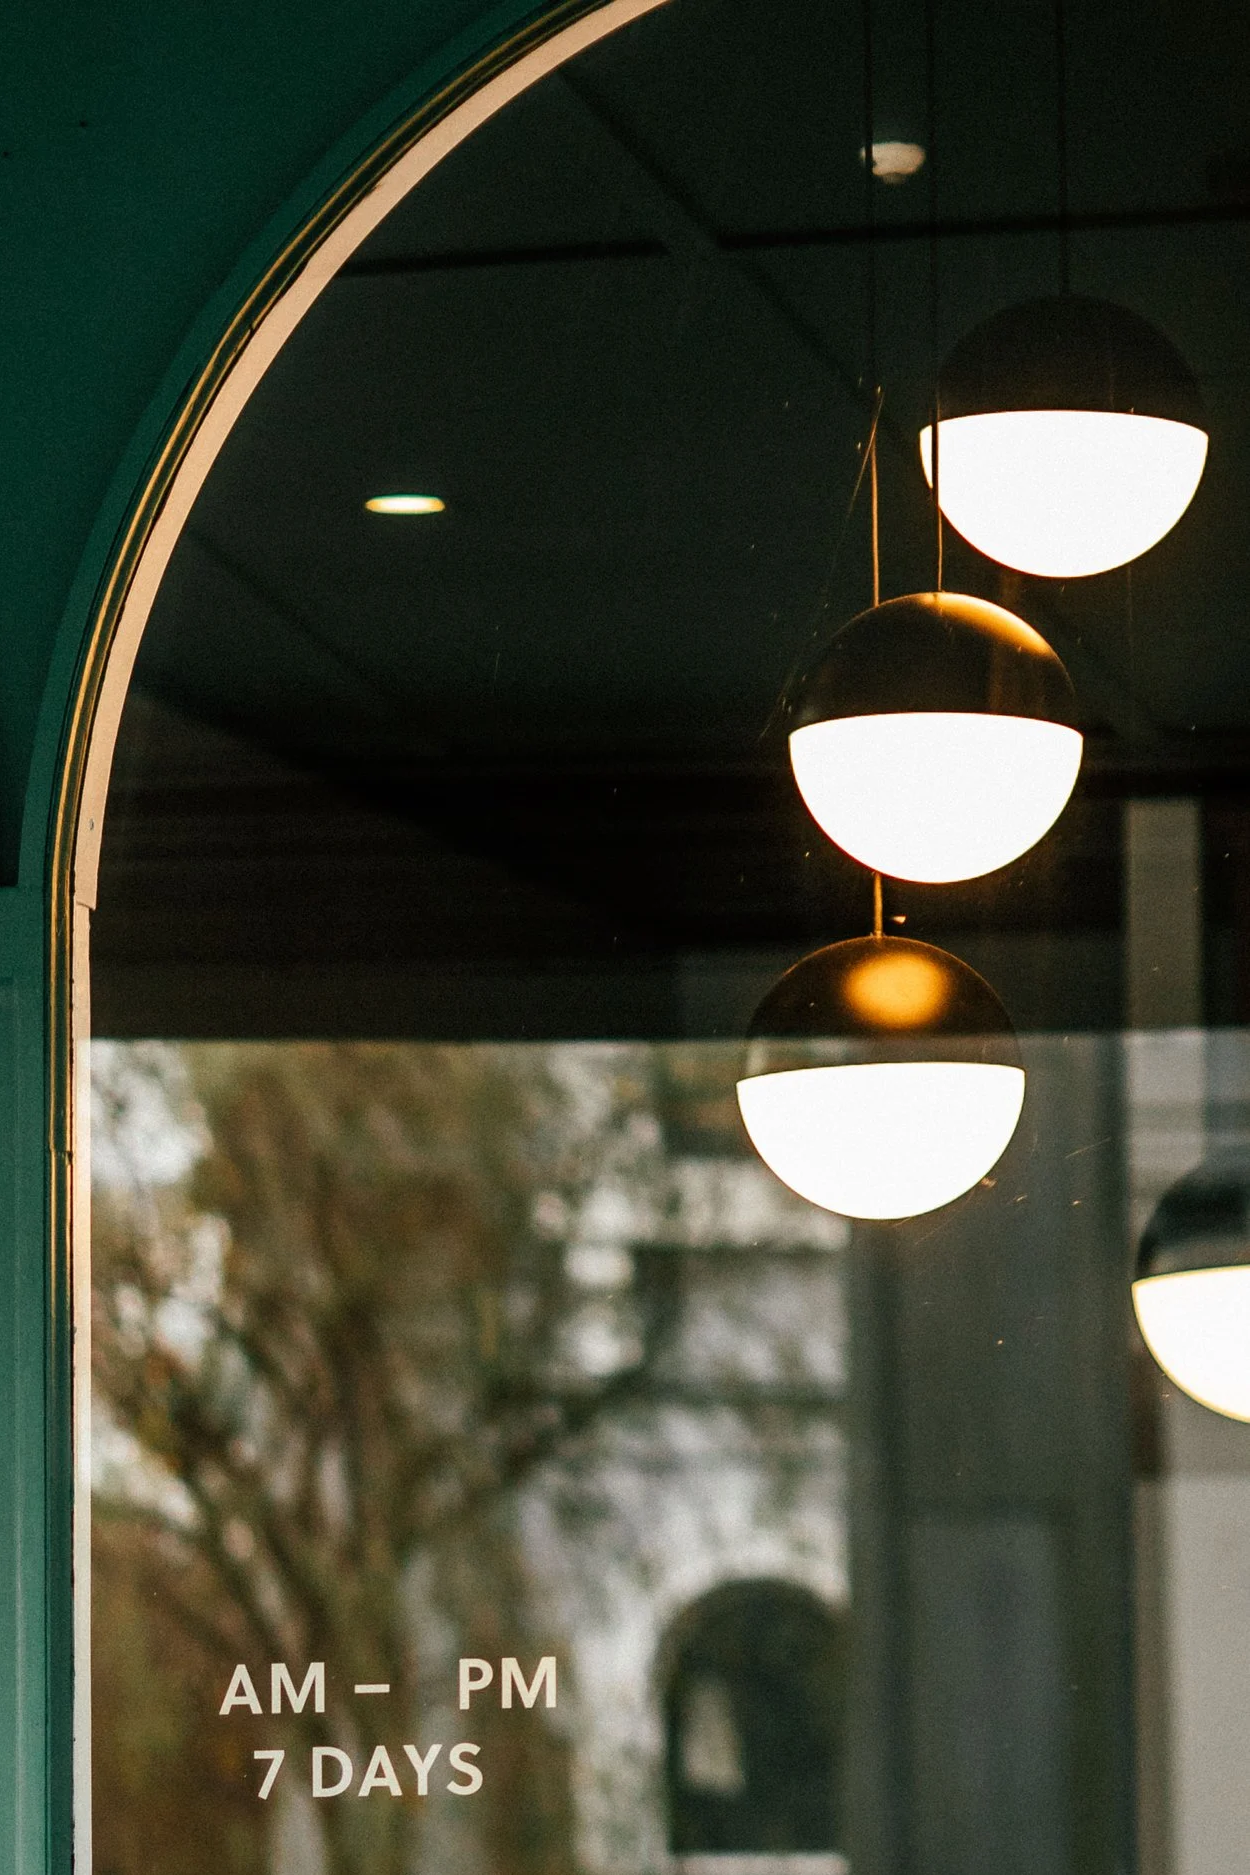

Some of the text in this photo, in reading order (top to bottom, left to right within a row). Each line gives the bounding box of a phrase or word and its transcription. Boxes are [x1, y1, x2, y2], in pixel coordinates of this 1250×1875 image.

[219, 1662, 325, 1715] AM
[459, 1656, 557, 1710] PM
[253, 1742, 483, 1800] 7 DAYS
